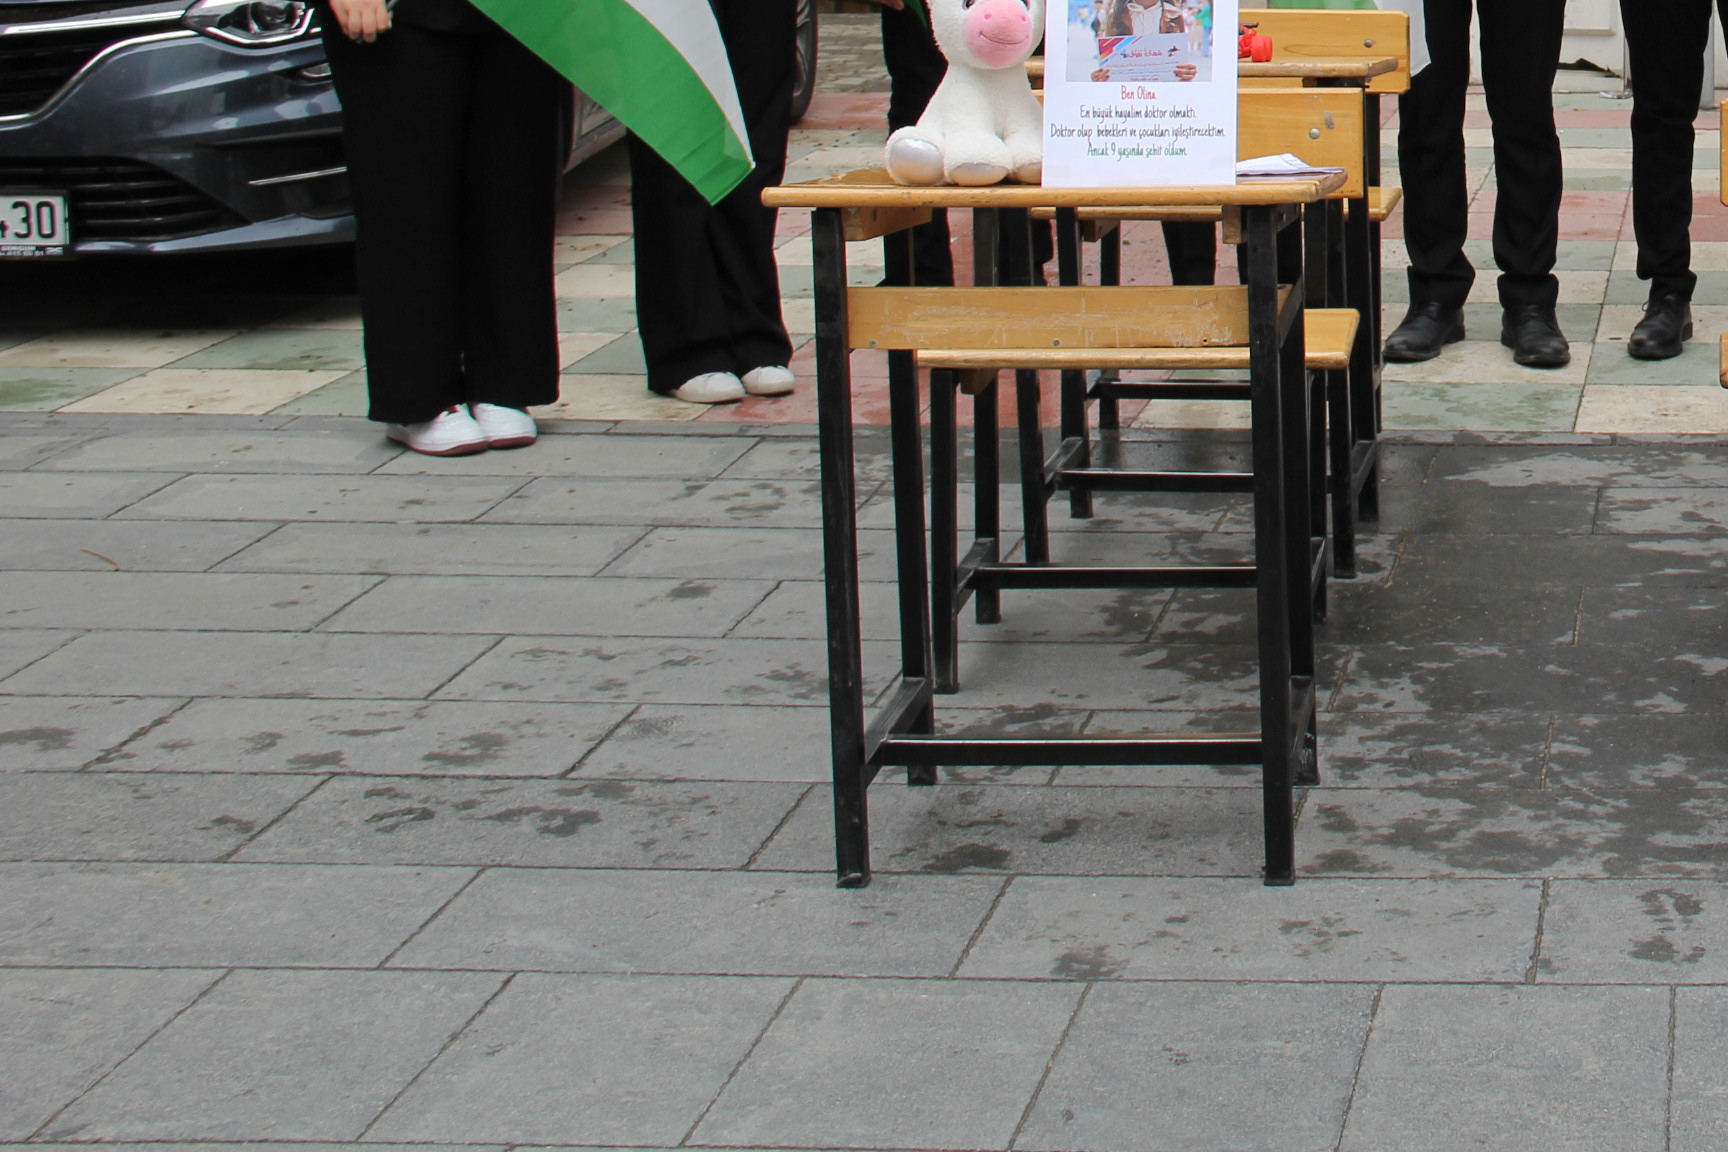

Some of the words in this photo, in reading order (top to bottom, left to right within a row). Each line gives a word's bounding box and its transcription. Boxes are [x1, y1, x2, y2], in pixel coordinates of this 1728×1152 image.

[1121, 86, 1134, 100] Ben
[1080, 105, 1090, 118] En
[1092, 105, 1113, 124] büyük
[1115, 105, 1142, 124] hayalim
[1144, 105, 1167, 118] doktor
[1169, 104, 1197, 118] olmaktı.
[1050, 123, 1075, 137] Doktor
[1077, 124, 1092, 143] olup
[1097, 123, 1127, 137] bebekleri
[1130, 128, 1137, 136] ve
[1140, 124, 1170, 139] çocukları
[1087, 142, 1109, 156] Ancak
[1111, 142, 1116, 156] 9
[1117, 143, 1143, 161] yaşında
[1146, 143, 1162, 158] şehit
